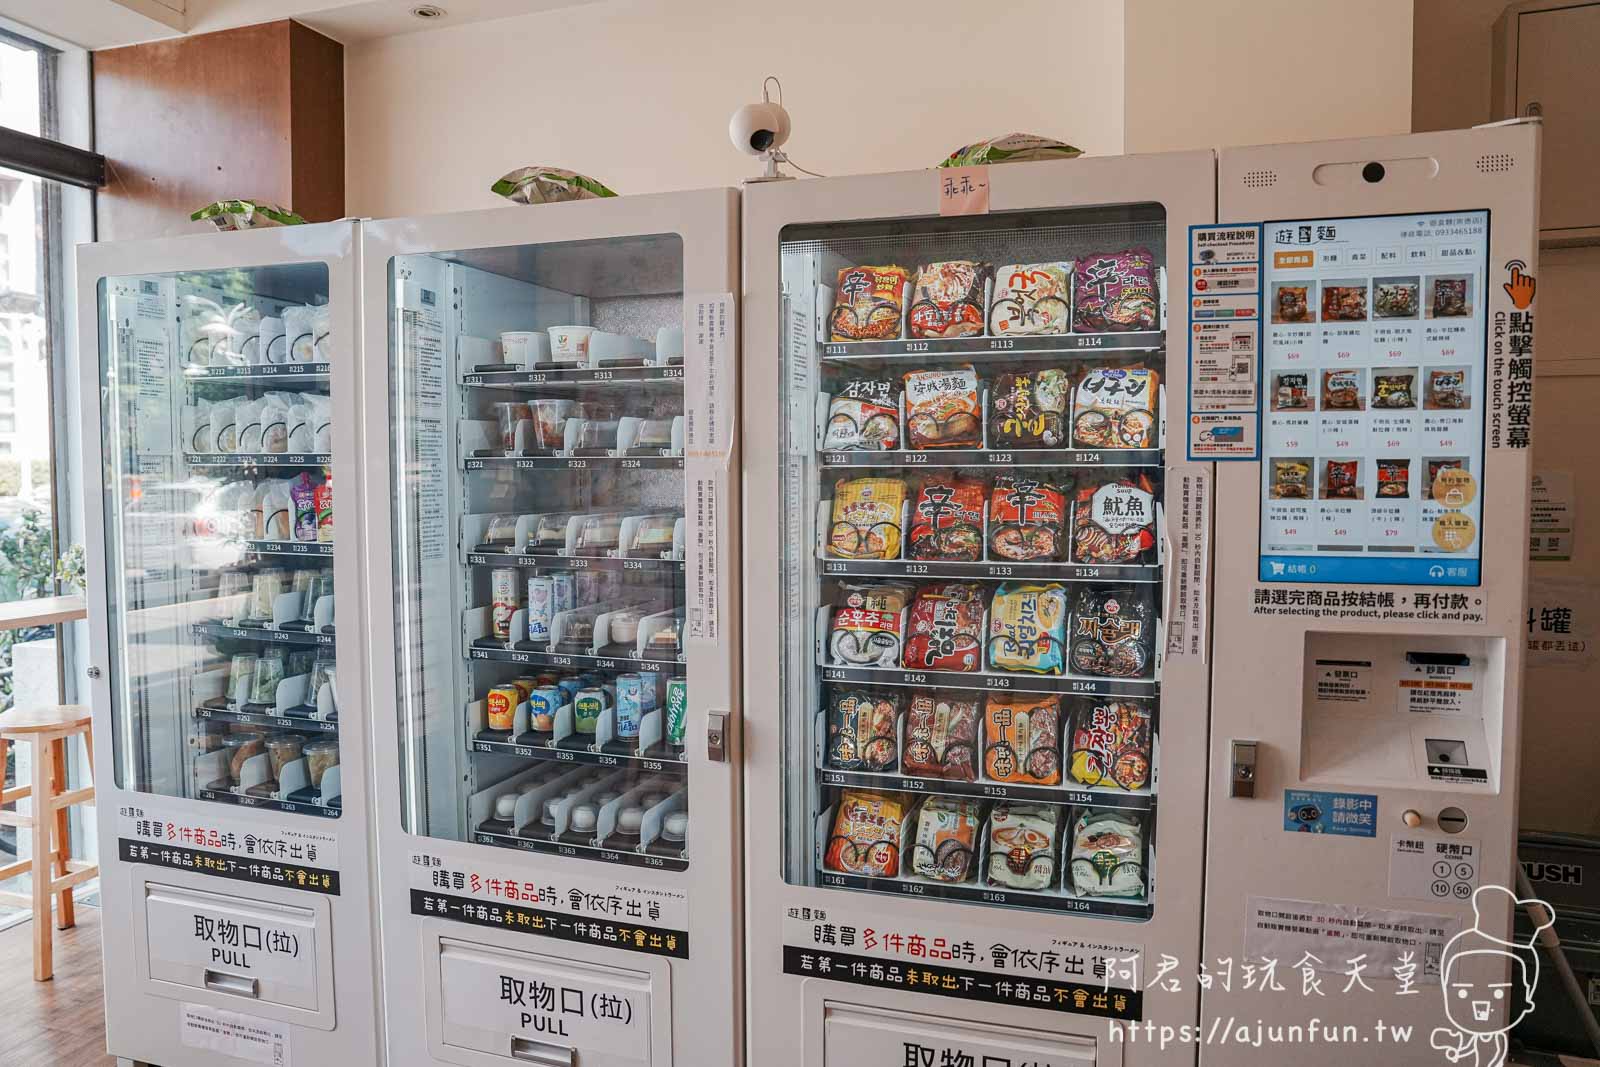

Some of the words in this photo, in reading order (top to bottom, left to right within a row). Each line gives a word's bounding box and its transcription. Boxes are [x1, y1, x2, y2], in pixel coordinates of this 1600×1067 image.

[1197, 230, 1255, 242] 購買流程說明
[842, 271, 872, 307] 辛
[1495, 311, 1505, 338] Click
[998, 340, 1014, 348] 113
[1084, 338, 1102, 346] 114
[913, 343, 929, 351] 112
[1495, 341, 1503, 355] on
[294, 365, 304, 373] 215
[1493, 358, 1504, 375] the
[599, 371, 612, 379] 313
[668, 369, 683, 377] 314
[533, 374, 546, 382] 312
[1507, 311, 1533, 448] 點擊觸控螢幕
[842, 381, 891, 398] 감자면
[913, 378, 967, 395] 安城湯麵
[1493, 378, 1504, 410] touch
[1492, 413, 1501, 448] screen
[995, 454, 1012, 462] 123
[1082, 454, 1100, 462] 124
[521, 460, 534, 468] 322
[573, 460, 586, 468] 323
[627, 460, 640, 468] 324
[1006, 479, 1046, 526] 辛
[1102, 495, 1145, 516] 魷魚
[919, 485, 963, 530] 辛
[474, 556, 486, 564] 331
[628, 561, 642, 569] 334
[995, 567, 1012, 575] 133
[1082, 569, 1099, 577] 134
[1254, 589, 1482, 610] 請選完商品按結帳，再付款。
[1254, 606, 1276, 615] After
[1278, 607, 1320, 617] selecting
[1322, 607, 1339, 616] the
[1340, 608, 1381, 618] product,
[1383, 609, 1415, 620] please
[1416, 609, 1439, 619] click
[1441, 610, 1460, 620] and
[1462, 612, 1483, 621] pay.
[838, 610, 880, 627] 순후추
[278, 632, 288, 640] 243
[516, 654, 529, 662] 342
[558, 657, 571, 665] 343
[601, 660, 614, 668] 344
[646, 663, 660, 671] 345
[910, 674, 926, 682] 142
[993, 679, 1009, 687] 143
[1079, 683, 1096, 691] 144
[480, 744, 492, 752] 351
[520, 748, 532, 756] 352
[561, 752, 574, 760] 353
[604, 757, 616, 765] 354
[648, 762, 662, 770] 355
[831, 774, 845, 782] 151
[991, 787, 1007, 795] 153
[1076, 794, 1092, 802] 154
[1333, 798, 1372, 811] 錄影中
[1332, 811, 1372, 825] 請微笑
[522, 841, 534, 849] 362
[1436, 842, 1473, 856] 硬幣口
[606, 852, 619, 860] 364
[650, 858, 663, 866] 365
[1523, 861, 1583, 885] USH
[909, 885, 924, 894] 162
[990, 894, 1005, 902] 163
[1074, 902, 1090, 910] 164
[194, 914, 299, 958] 取物口(拉)
[211, 947, 251, 969] PULL
[499, 975, 632, 1024] 取物口(拉)
[521, 1012, 569, 1037] PULL
